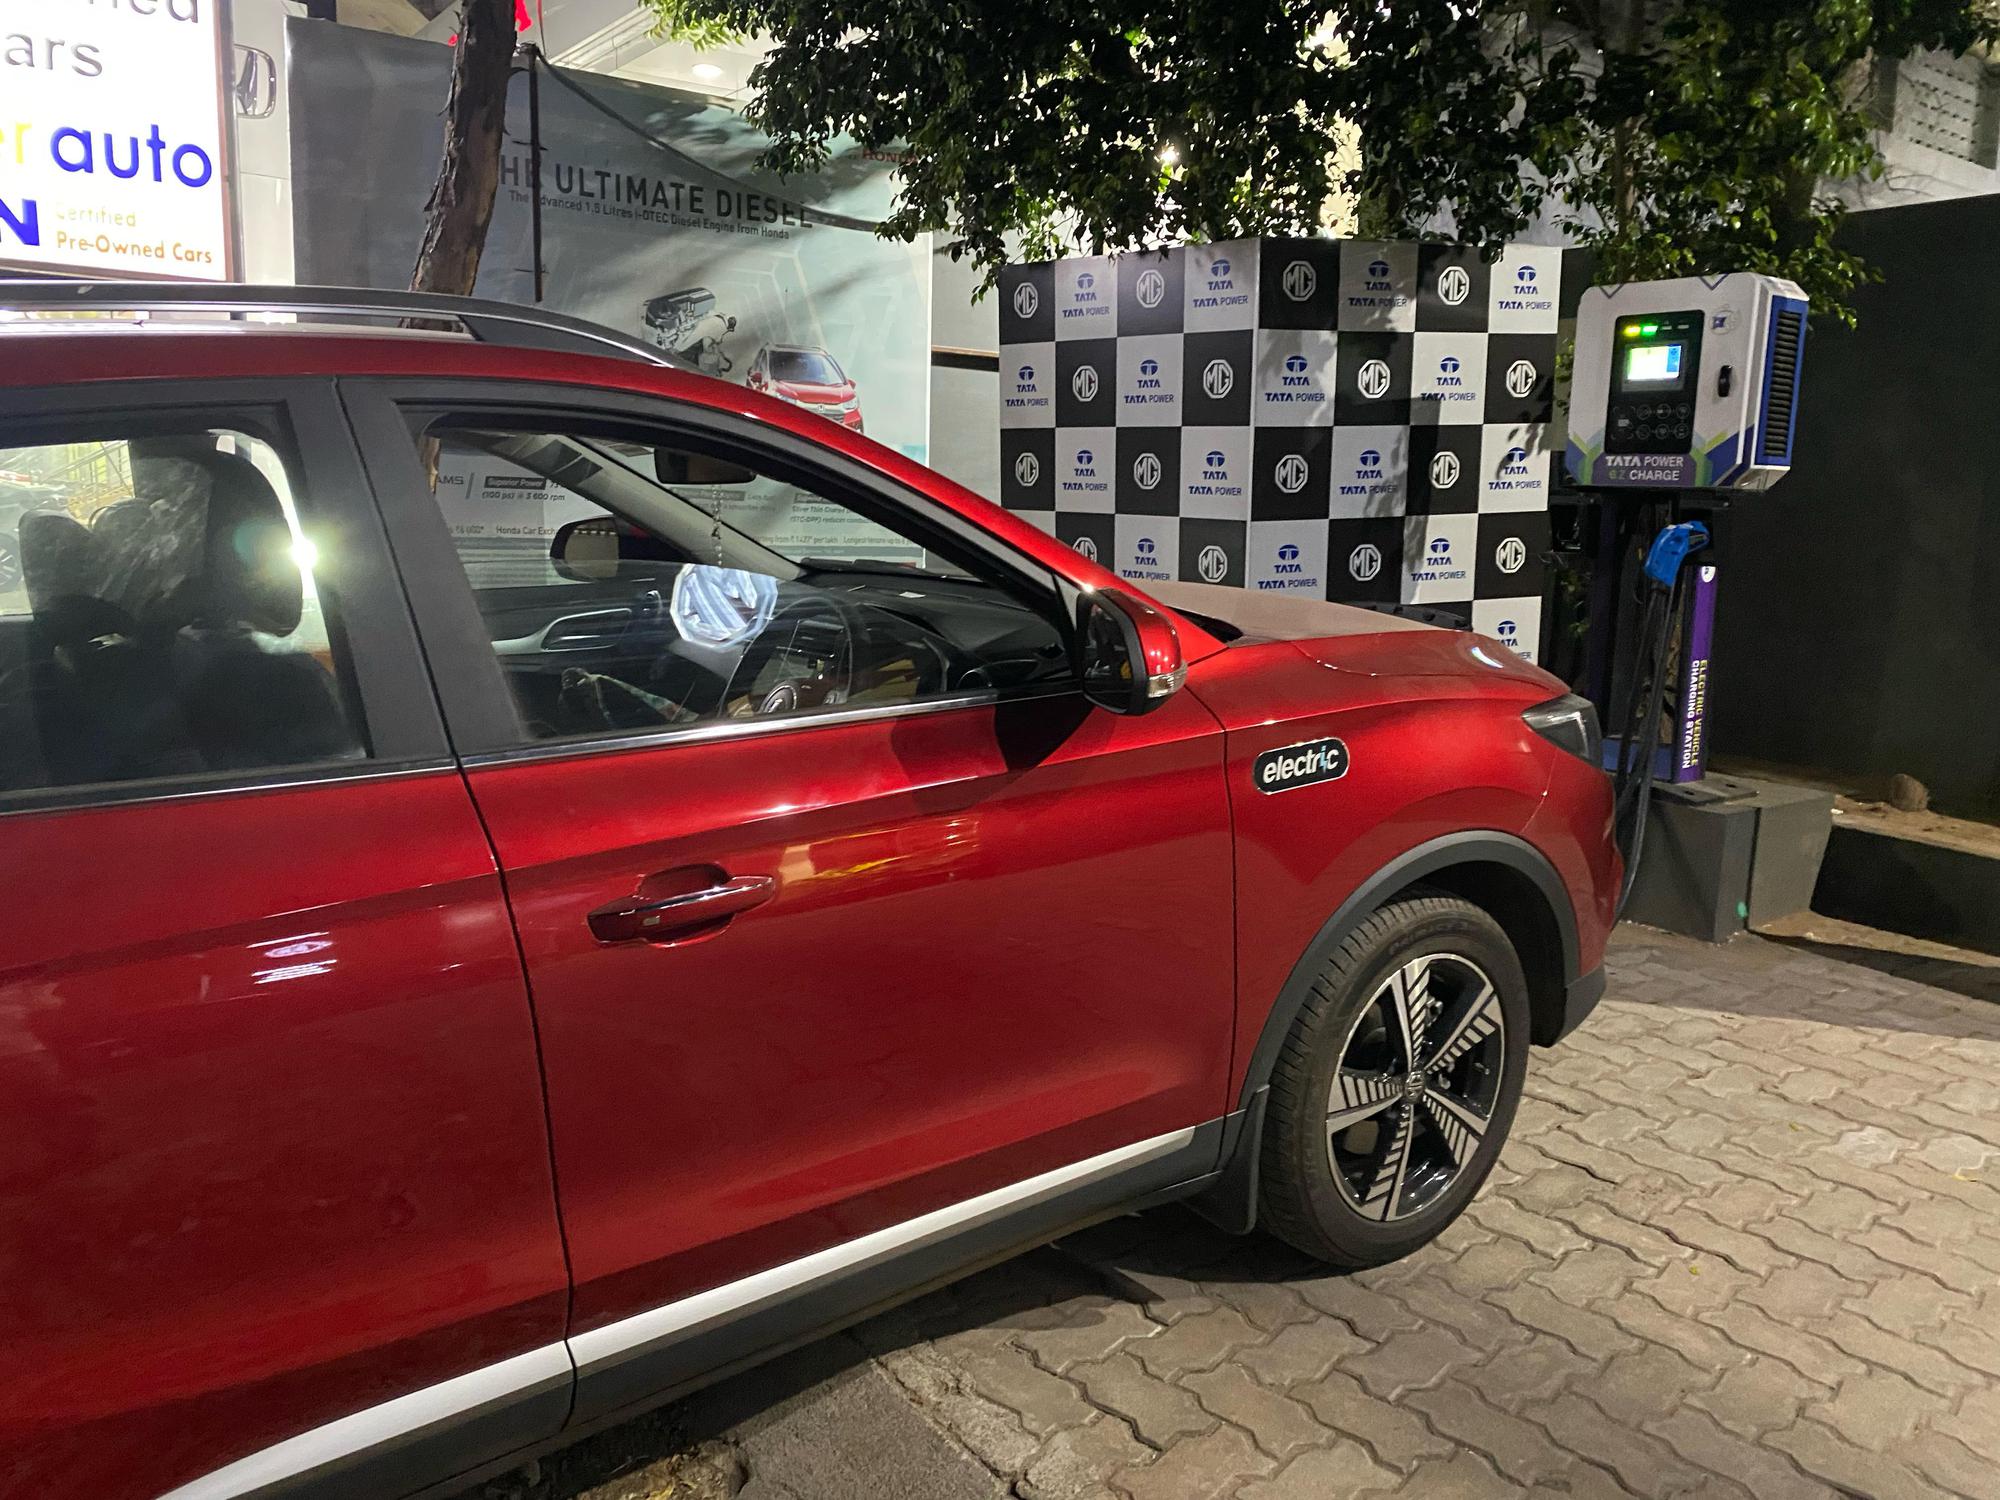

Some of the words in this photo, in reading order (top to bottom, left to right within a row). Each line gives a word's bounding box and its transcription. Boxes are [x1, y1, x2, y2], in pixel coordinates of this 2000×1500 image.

[4, 33, 103, 77] ars
[50, 124, 212, 188] auto
[501, 155, 537, 188] HE
[556, 163, 704, 214] ULTIMATE
[717, 188, 813, 229] DIESEL
[509, 190, 528, 203] The
[540, 195, 582, 211] dvanced
[603, 204, 632, 219] Litres
[671, 215, 700, 228] Diesel
[704, 218, 735, 233] Engine
[737, 223, 758, 235] from
[762, 226, 789, 239] Honda
[57, 231, 164, 259] Pre-Owned
[173, 242, 212, 263] Cars
[1208, 280, 1233, 290] TATA
[1285, 263, 1314, 298] MG
[1440, 269, 1467, 302] MG
[1138, 272, 1163, 305] MG
[1365, 282, 1392, 291] TATA
[1513, 286, 1538, 295] TATA
[1016, 285, 1036, 315] MG
[1074, 292, 1097, 302] TATA
[1192, 297, 1219, 308] TATA
[1220, 295, 1249, 306] POWER
[1348, 297, 1376, 307] TATA
[1378, 298, 1407, 308] POWER
[1498, 301, 1523, 310] TATA
[1525, 301, 1552, 310] POWER
[1062, 309, 1084, 318] TATA
[1085, 306, 1110, 317] POWER
[1075, 368, 1096, 399] MG
[1137, 379, 1161, 389] TATA
[1205, 362, 1231, 396] MG
[1282, 376, 1310, 386] TATA
[1360, 363, 1388, 396] MG
[1436, 377, 1461, 386] TATA
[1508, 363, 1534, 395] MG
[1016, 384, 1037, 393] TATA
[1124, 395, 1147, 404] TATA
[1149, 394, 1174, 403] POWER
[1265, 393, 1293, 402] TATA
[1295, 392, 1325, 402] POWER
[1421, 392, 1446, 401] TATA
[1449, 392, 1476, 401] POWER
[1005, 399, 1026, 407] TATA
[1027, 398, 1049, 407] POWER
[1605, 456, 1641, 467] TATA
[1644, 456, 1684, 467] POWER
[1017, 454, 1037, 484] MG
[1074, 468, 1095, 477] TATA
[1136, 456, 1159, 487] MG
[1277, 457, 1307, 490] MG
[1356, 470, 1383, 479] TATA
[1431, 454, 1458, 486] MG
[1503, 465, 1528, 475] TATA
[437, 476, 464, 485] AMS
[1202, 470, 1227, 480] TATA
[1629, 470, 1680, 481] CHARGE
[520, 479, 543, 488] Power
[1062, 482, 1083, 491] TATA
[1085, 482, 1108, 491] POWER
[1488, 481, 1513, 490] TATA
[1515, 480, 1541, 489] POWER
[1188, 486, 1213, 495] TATA
[1215, 486, 1242, 496] POWER
[1340, 486, 1367, 495] TATA
[1369, 485, 1398, 494] POWER
[496, 525, 520, 535] Honda
[523, 527, 536, 535] Car
[538, 527, 555, 535] Exch
[1134, 556, 1158, 566] TATA
[1426, 556, 1452, 566] TATA
[1498, 540, 1524, 571] MG
[1200, 548, 1225, 580] MG
[1274, 563, 1302, 573] TATA
[1352, 547, 1379, 578] MG
[1122, 569, 1144, 579] TATA
[1145, 571, 1170, 581] POWER
[1411, 572, 1437, 582] TATA
[1438, 570, 1466, 580] POWER
[1257, 580, 1285, 589] TATA
[1287, 578, 1317, 588] POWER
[1499, 638, 1518, 647] ATA
[1687, 660, 1699, 719] CHARGING
[1695, 660, 1707, 715] ELECTRIC
[1682, 721, 1694, 769] STATION
[1691, 719, 1702, 766] VEHICLE
[1263, 746, 1339, 784] electric
